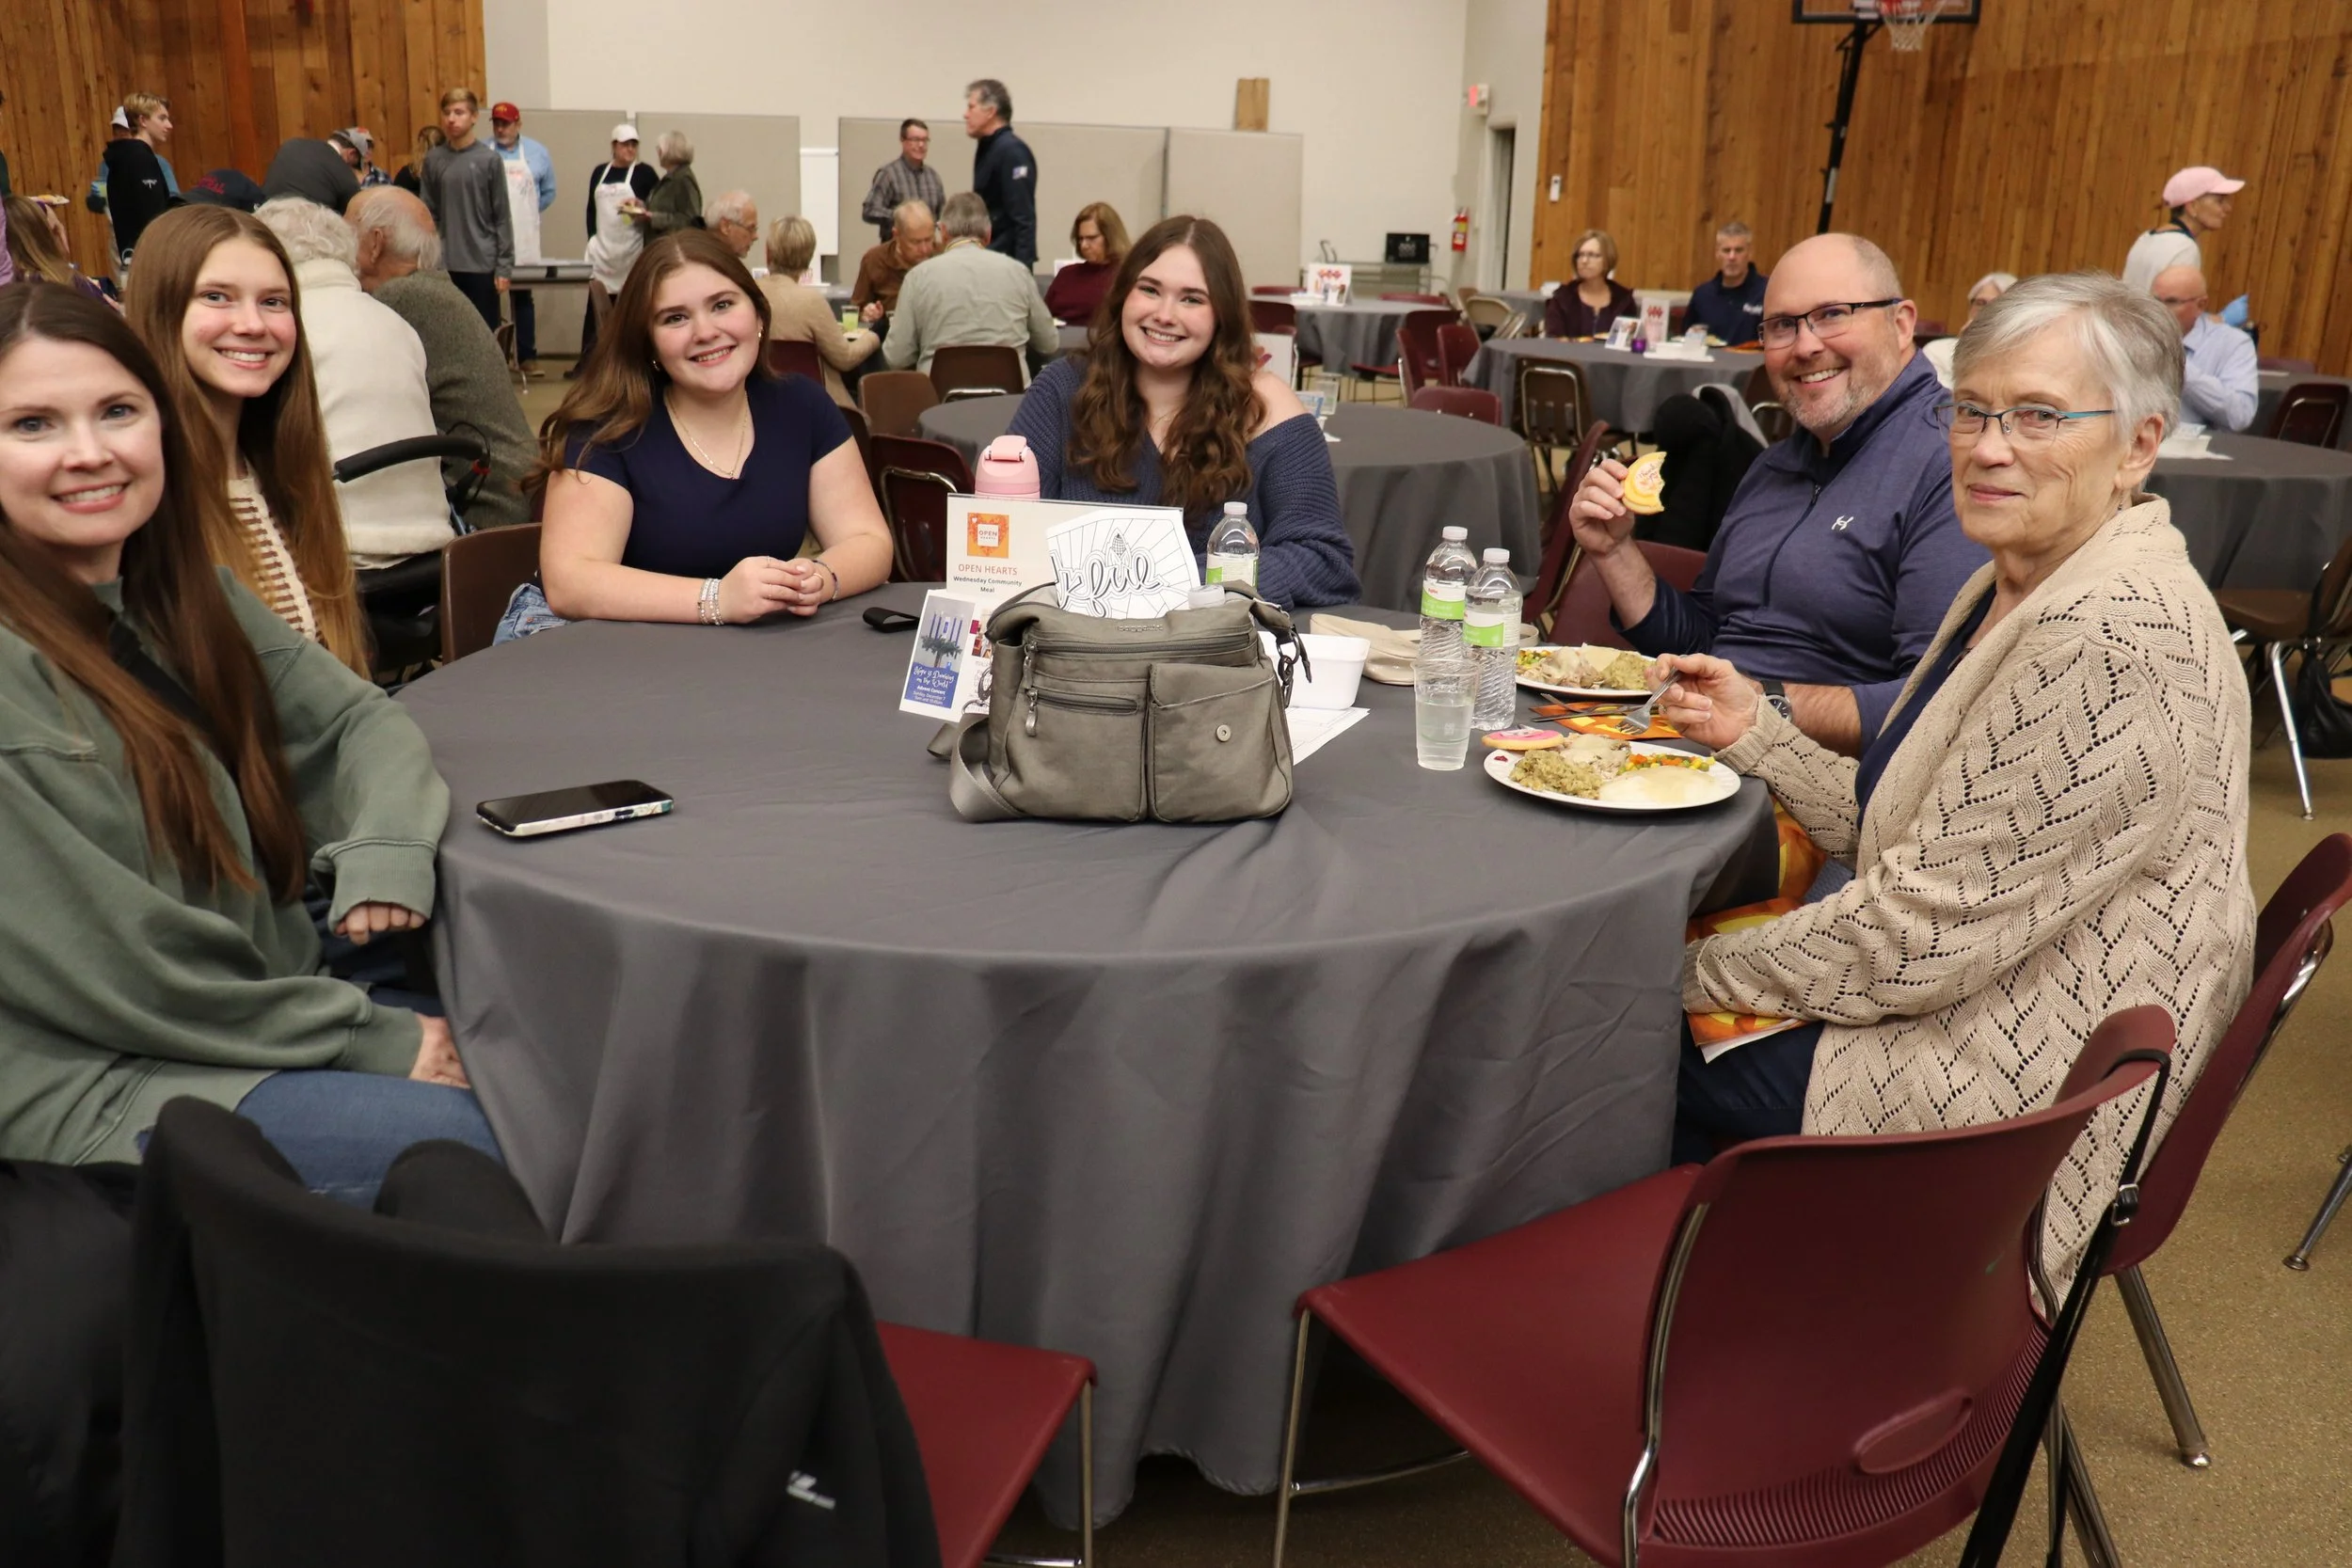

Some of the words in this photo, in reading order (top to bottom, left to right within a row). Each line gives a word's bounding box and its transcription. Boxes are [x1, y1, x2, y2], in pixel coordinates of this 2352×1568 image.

[958, 563, 982, 573] OPEN
[984, 565, 1018, 576] HEARTS
[953, 576, 987, 584] Wednesday
[987, 578, 1023, 587] Community
[914, 666, 927, 675] Hope
[932, 671, 954, 683] Dawning
[931, 678, 948, 689] World
